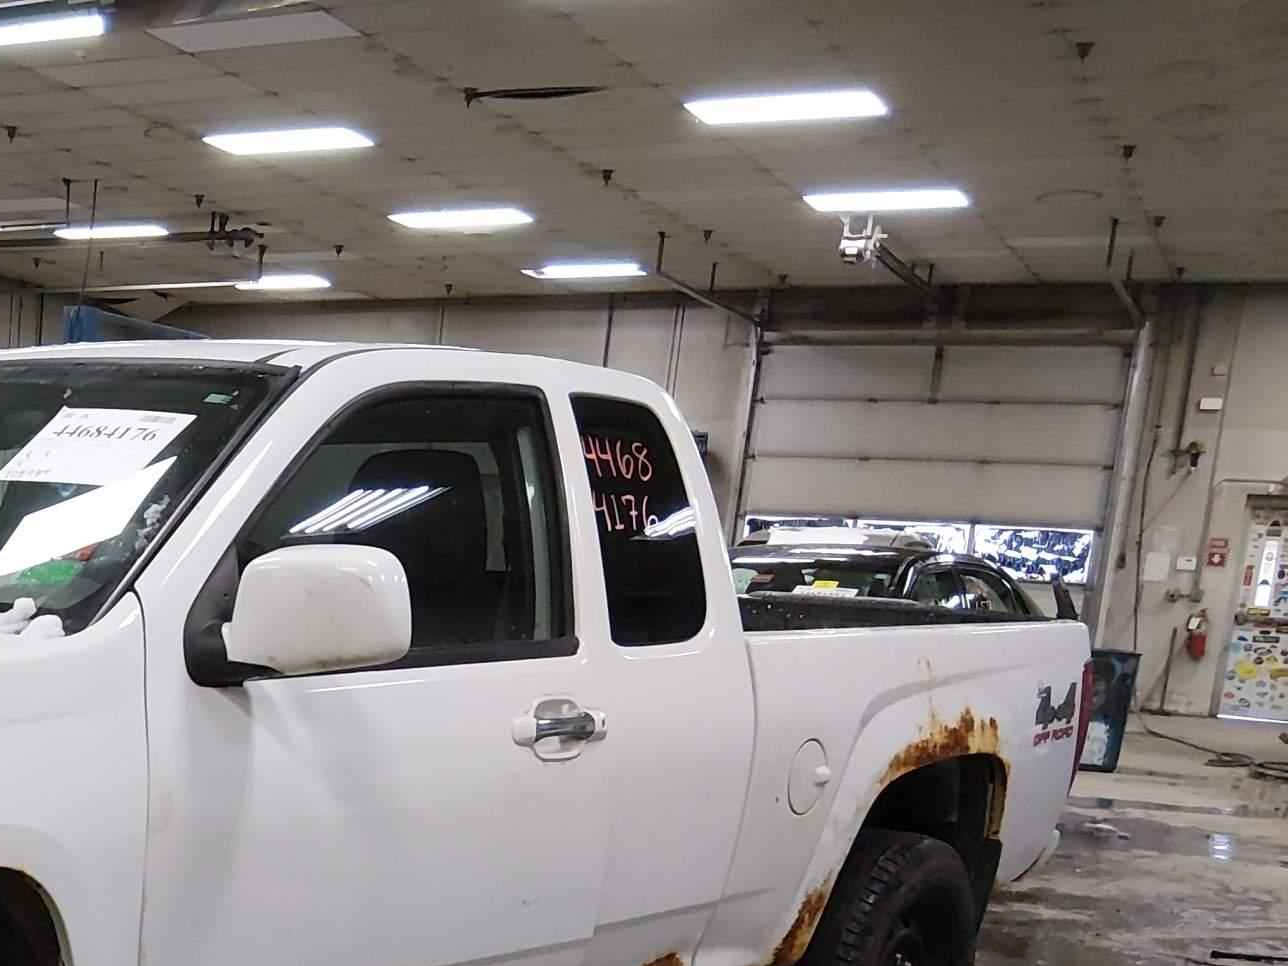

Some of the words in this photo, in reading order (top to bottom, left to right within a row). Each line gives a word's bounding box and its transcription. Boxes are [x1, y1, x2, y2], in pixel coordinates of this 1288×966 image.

[53, 424, 162, 442] 44684176
[581, 434, 652, 481] 4468
[592, 490, 660, 537] 4176
